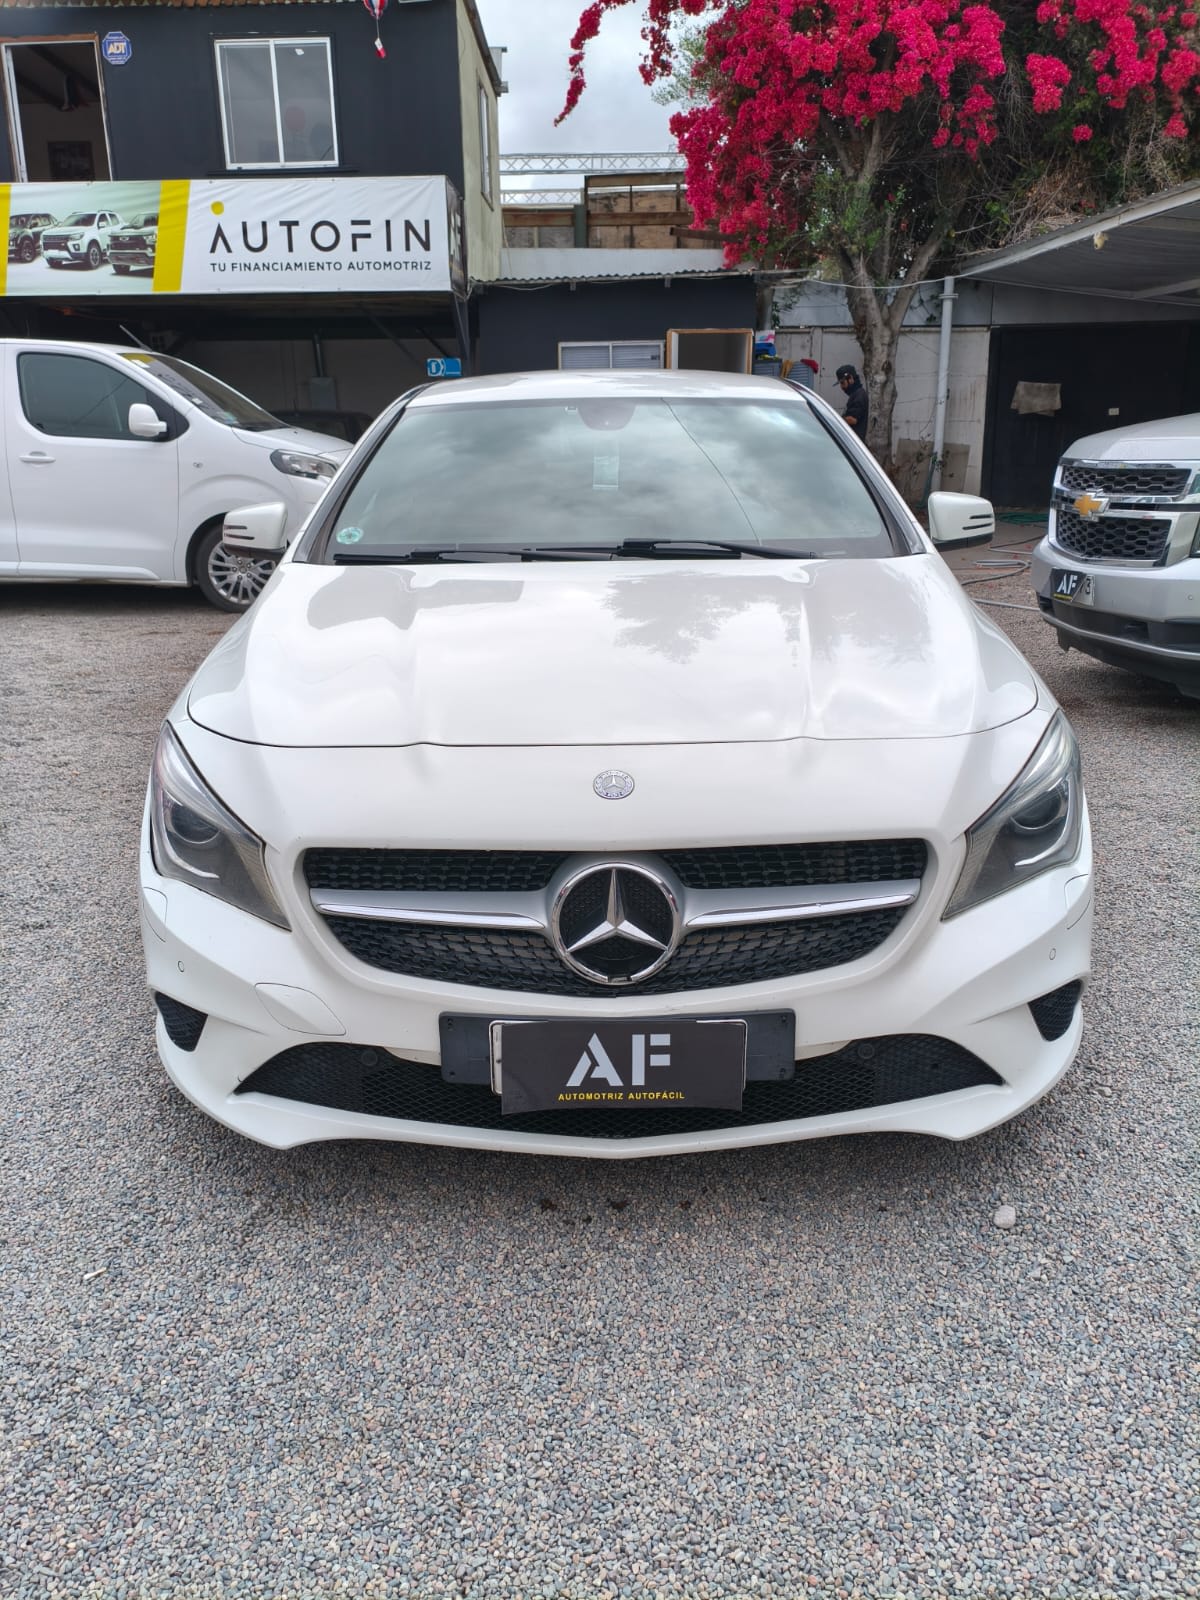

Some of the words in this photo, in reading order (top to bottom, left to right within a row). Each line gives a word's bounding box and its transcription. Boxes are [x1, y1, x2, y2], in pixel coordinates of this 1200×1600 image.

[108, 42, 126, 54] ADT
[209, 219, 431, 254] AUTOFIN
[210, 263, 226, 272] TU
[231, 261, 343, 272] FINANCIAMIENTO
[347, 261, 432, 271] AUTOMOTRIZ
[1056, 573, 1078, 595] AF
[566, 1032, 671, 1087] AF
[558, 1092, 624, 1101] AUTOMOTRIZ
[628, 1090, 685, 1100] AUTOFÁCIL
